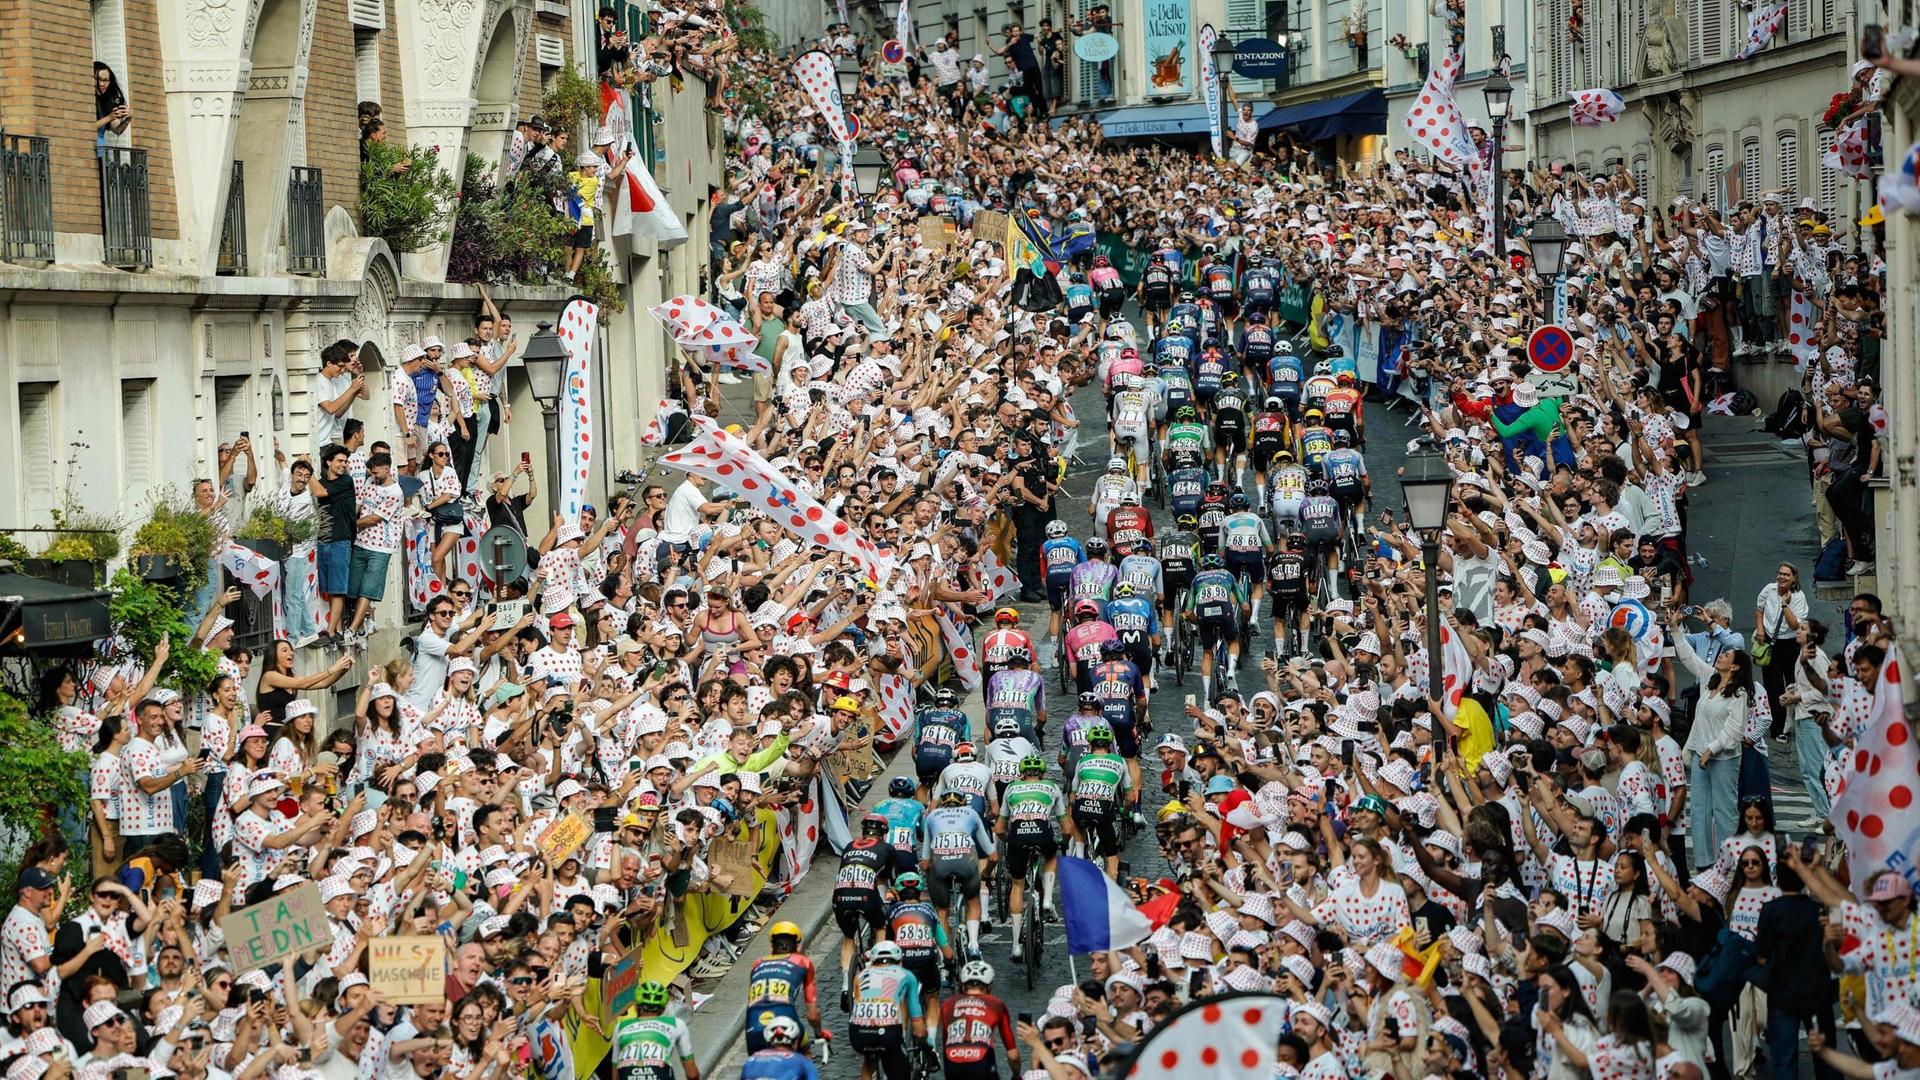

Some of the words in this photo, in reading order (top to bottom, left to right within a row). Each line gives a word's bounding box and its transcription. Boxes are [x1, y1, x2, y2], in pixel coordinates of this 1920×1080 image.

[1158, 4, 1184, 20] Belle
[1149, 21, 1186, 37] Maison
[1235, 52, 1284, 62] TENTAZIONI
[1327, 401, 1338, 411] 25
[1308, 442, 1317, 450] 35
[1320, 440, 1330, 449] 35
[1279, 479, 1290, 489] 34
[1292, 478, 1302, 489] 34
[1115, 519, 1139, 528] lotto
[1202, 513, 1213, 524] 98
[1232, 535, 1243, 546] 68
[1248, 535, 1259, 546] 68
[1202, 588, 1213, 599] 98
[1215, 586, 1226, 598] 98
[498, 603, 517, 613] SAUF
[1077, 623, 1102, 638] EF
[1113, 682, 1129, 696] 216
[1011, 691, 1027, 703] 113
[1103, 703, 1126, 712] aisin
[923, 726, 935, 737] 76
[944, 729, 955, 741] 76
[993, 761, 1009, 775] 133
[966, 776, 983, 791] 202
[1079, 806, 1104, 815] RURAL
[1084, 800, 1101, 808] CAJA
[551, 822, 571, 843] Baby
[899, 831, 911, 844] 61
[1016, 827, 1043, 837] RURAL
[934, 834, 950, 849] 175
[953, 833, 971, 848] 175
[843, 850, 878, 861] TUDOR
[855, 867, 875, 883] 196
[246, 894, 307, 933] TEAM
[900, 924, 915, 939] 58
[917, 924, 931, 937] 58
[234, 913, 327, 969] MEDDING
[375, 945, 423, 961] NILS
[906, 949, 930, 959] Shine
[371, 967, 441, 983] MASCHINE
[772, 983, 786, 996] 32
[853, 1003, 874, 1018] 136
[876, 1003, 897, 1018] 136
[948, 1021, 966, 1037] 56
[949, 1048, 981, 1062] caps
[631, 1066, 655, 1076] CAJA
